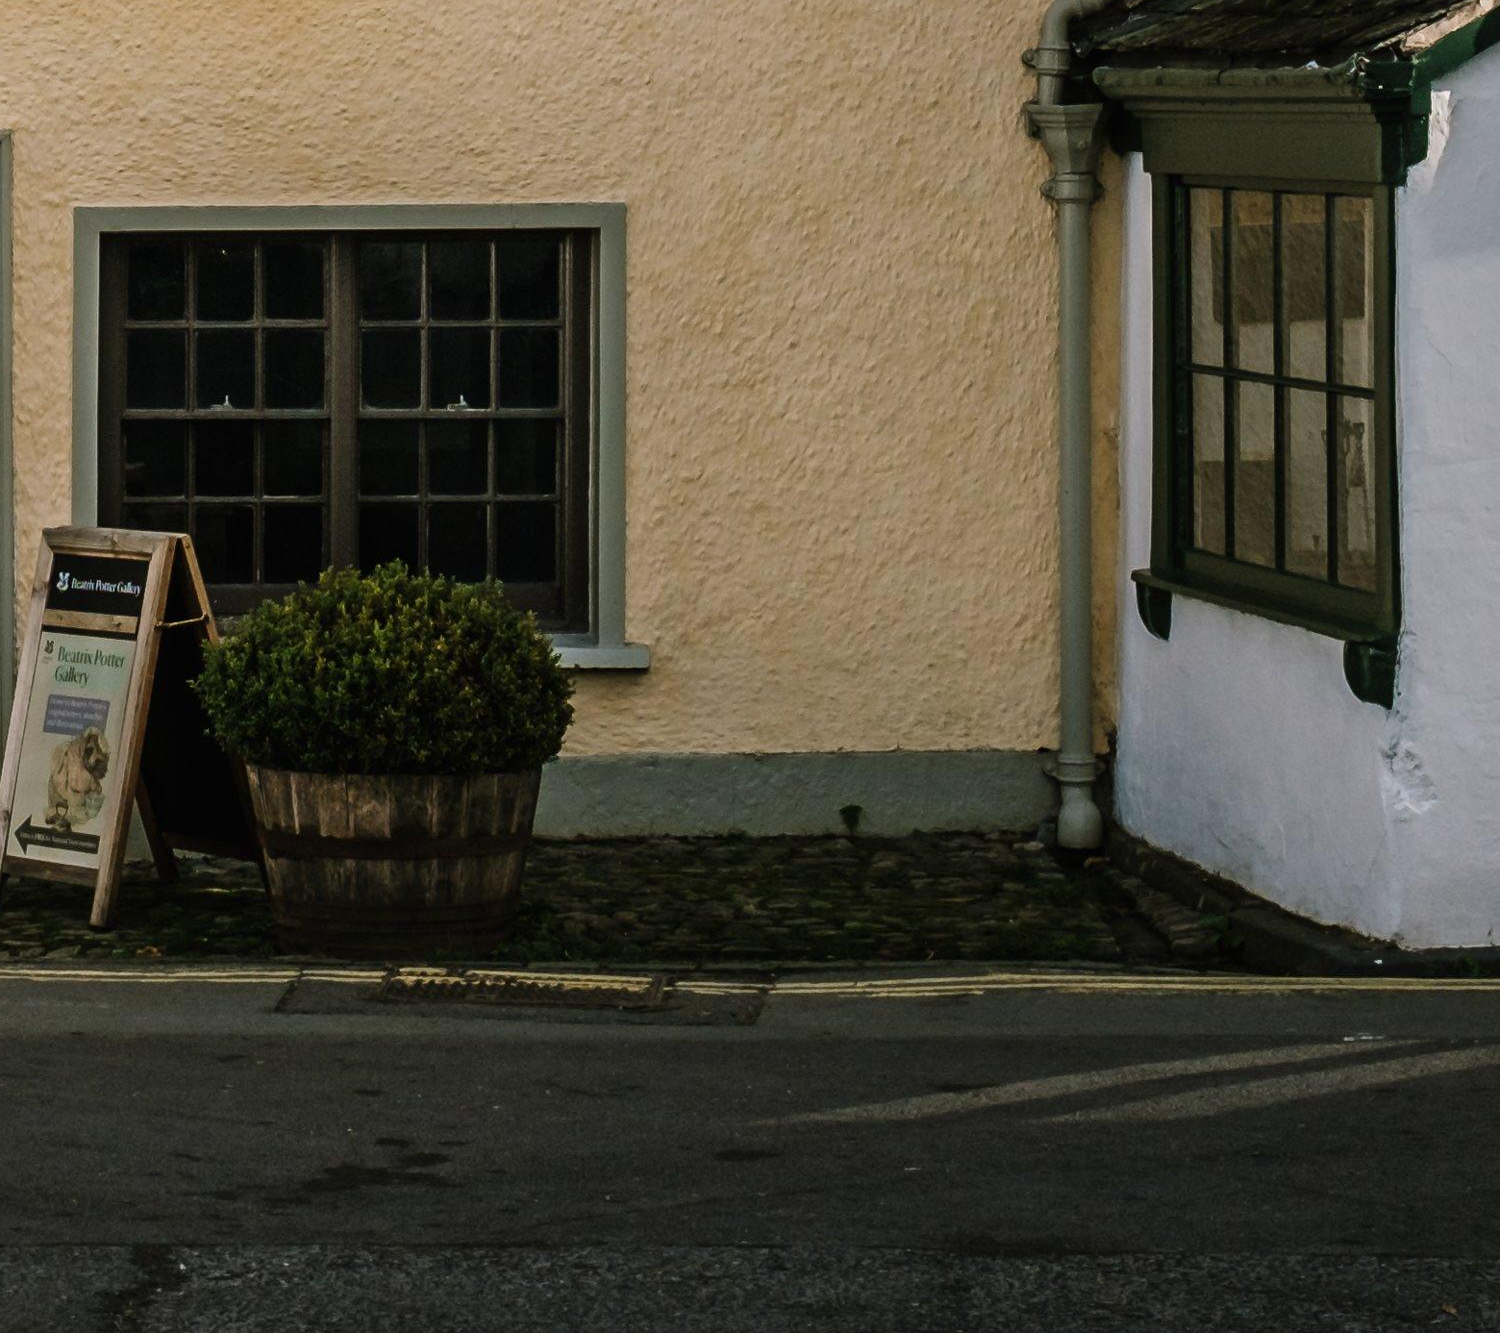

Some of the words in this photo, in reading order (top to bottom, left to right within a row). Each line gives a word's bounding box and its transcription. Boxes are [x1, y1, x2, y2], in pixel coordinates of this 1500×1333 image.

[71, 577, 95, 591] Beatrix
[95, 579, 116, 593] Potter
[117, 581, 141, 598] Gallery
[57, 645, 92, 665] Beatrix
[94, 648, 126, 669] Potter
[54, 666, 89, 688] Gallery
